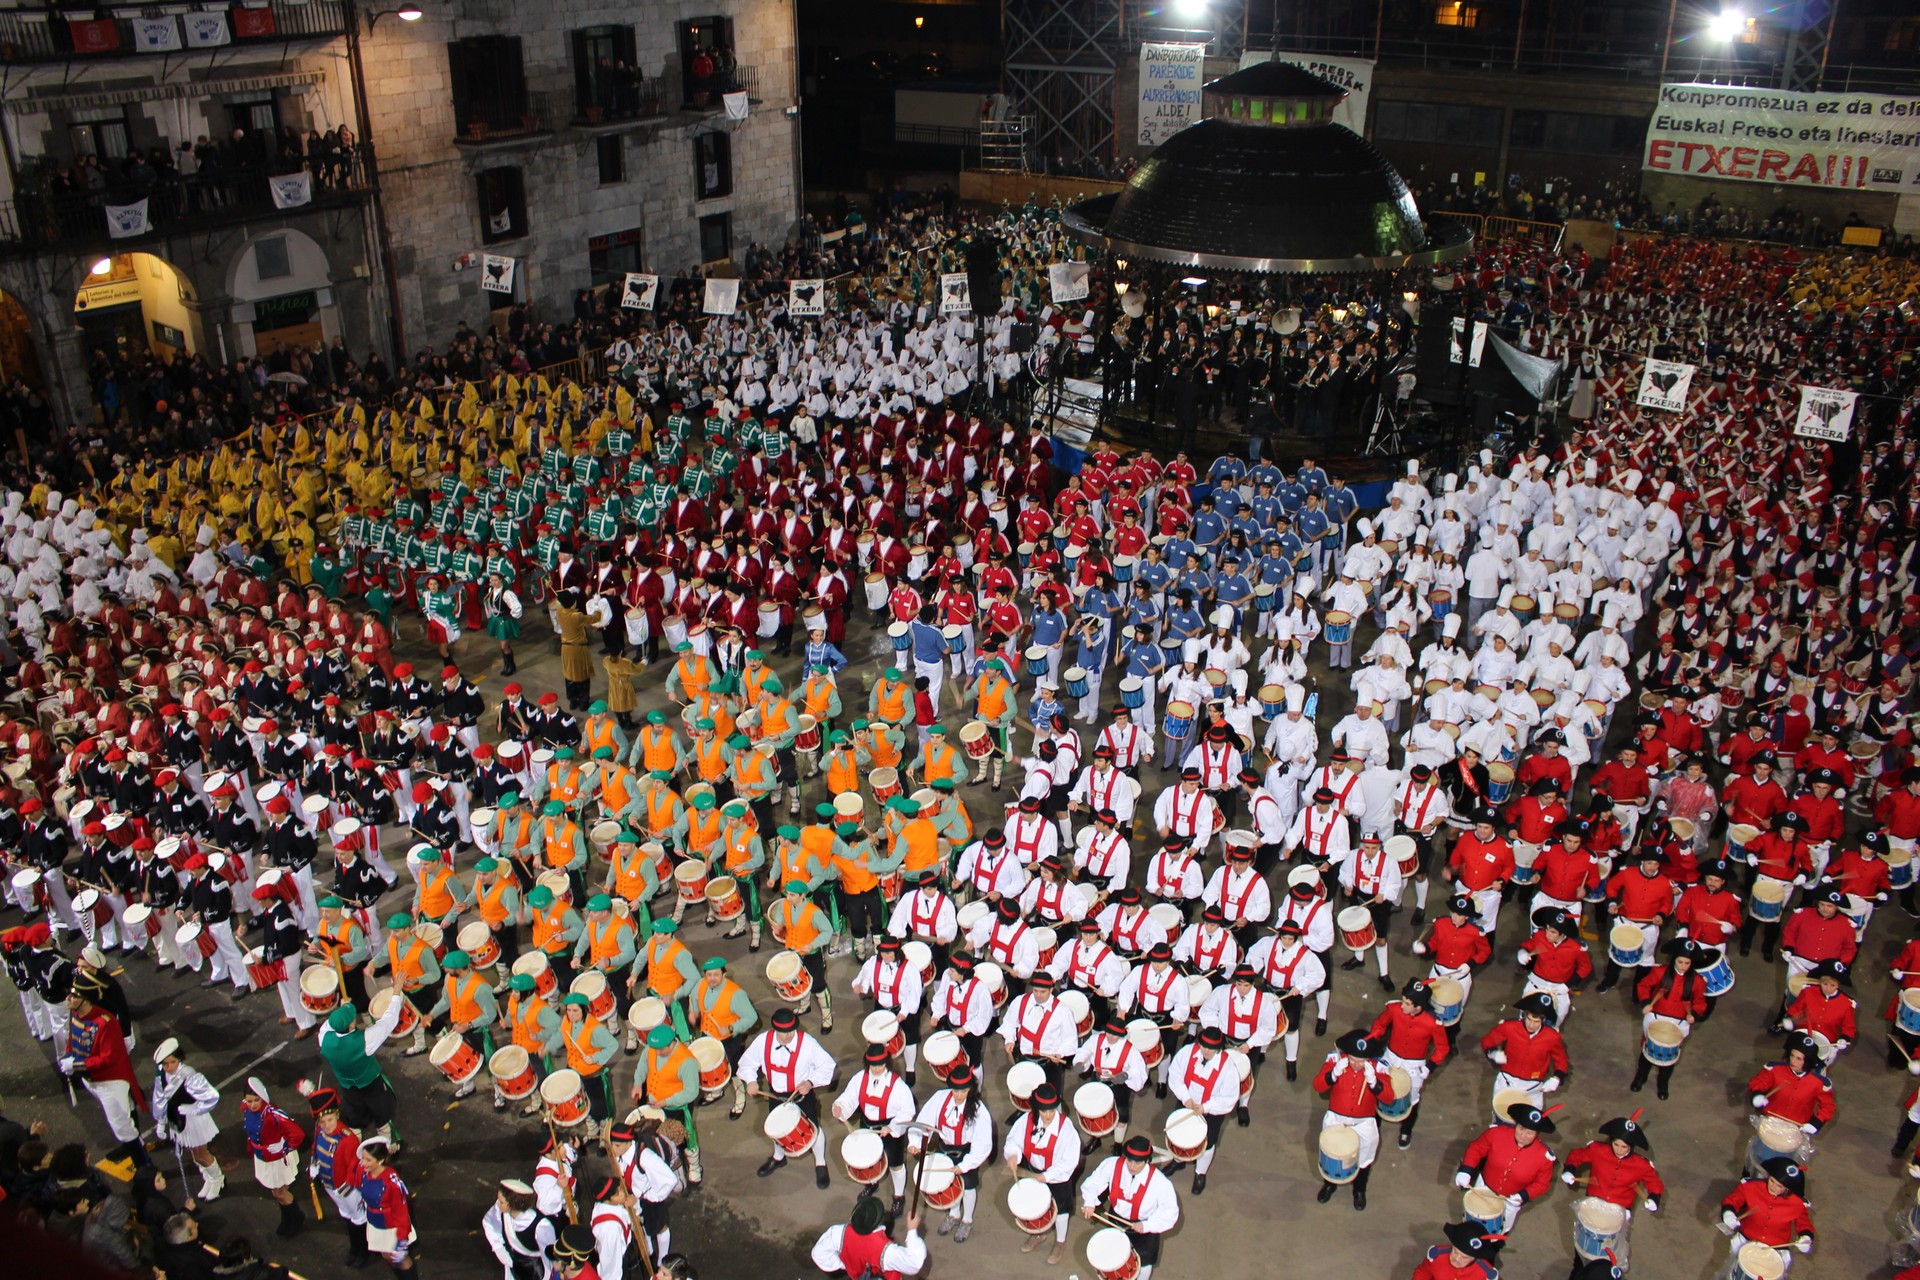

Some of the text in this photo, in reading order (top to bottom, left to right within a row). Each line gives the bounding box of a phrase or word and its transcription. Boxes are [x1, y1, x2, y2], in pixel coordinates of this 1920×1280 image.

[1145, 49, 1201, 63] DANBORRADA
[1149, 64, 1195, 79] PAREKIDE
[1309, 62, 1355, 80] PRESO
[1319, 72, 1364, 92] ARIAK
[1660, 87, 1808, 112] Konpromezua
[1816, 101, 1840, 113] ez
[1846, 99, 1872, 115] da
[1656, 115, 1725, 134] Euskal
[1732, 120, 1793, 139] Preso
[1798, 126, 1831, 141] eta
[1648, 139, 1869, 188] ETXERA!!!
[484, 282, 509, 291] ETXERA
[623, 299, 651, 308] ETXERA
[1641, 395, 1681, 409] ETXERA
[1800, 425, 1844, 440] ETXERA
